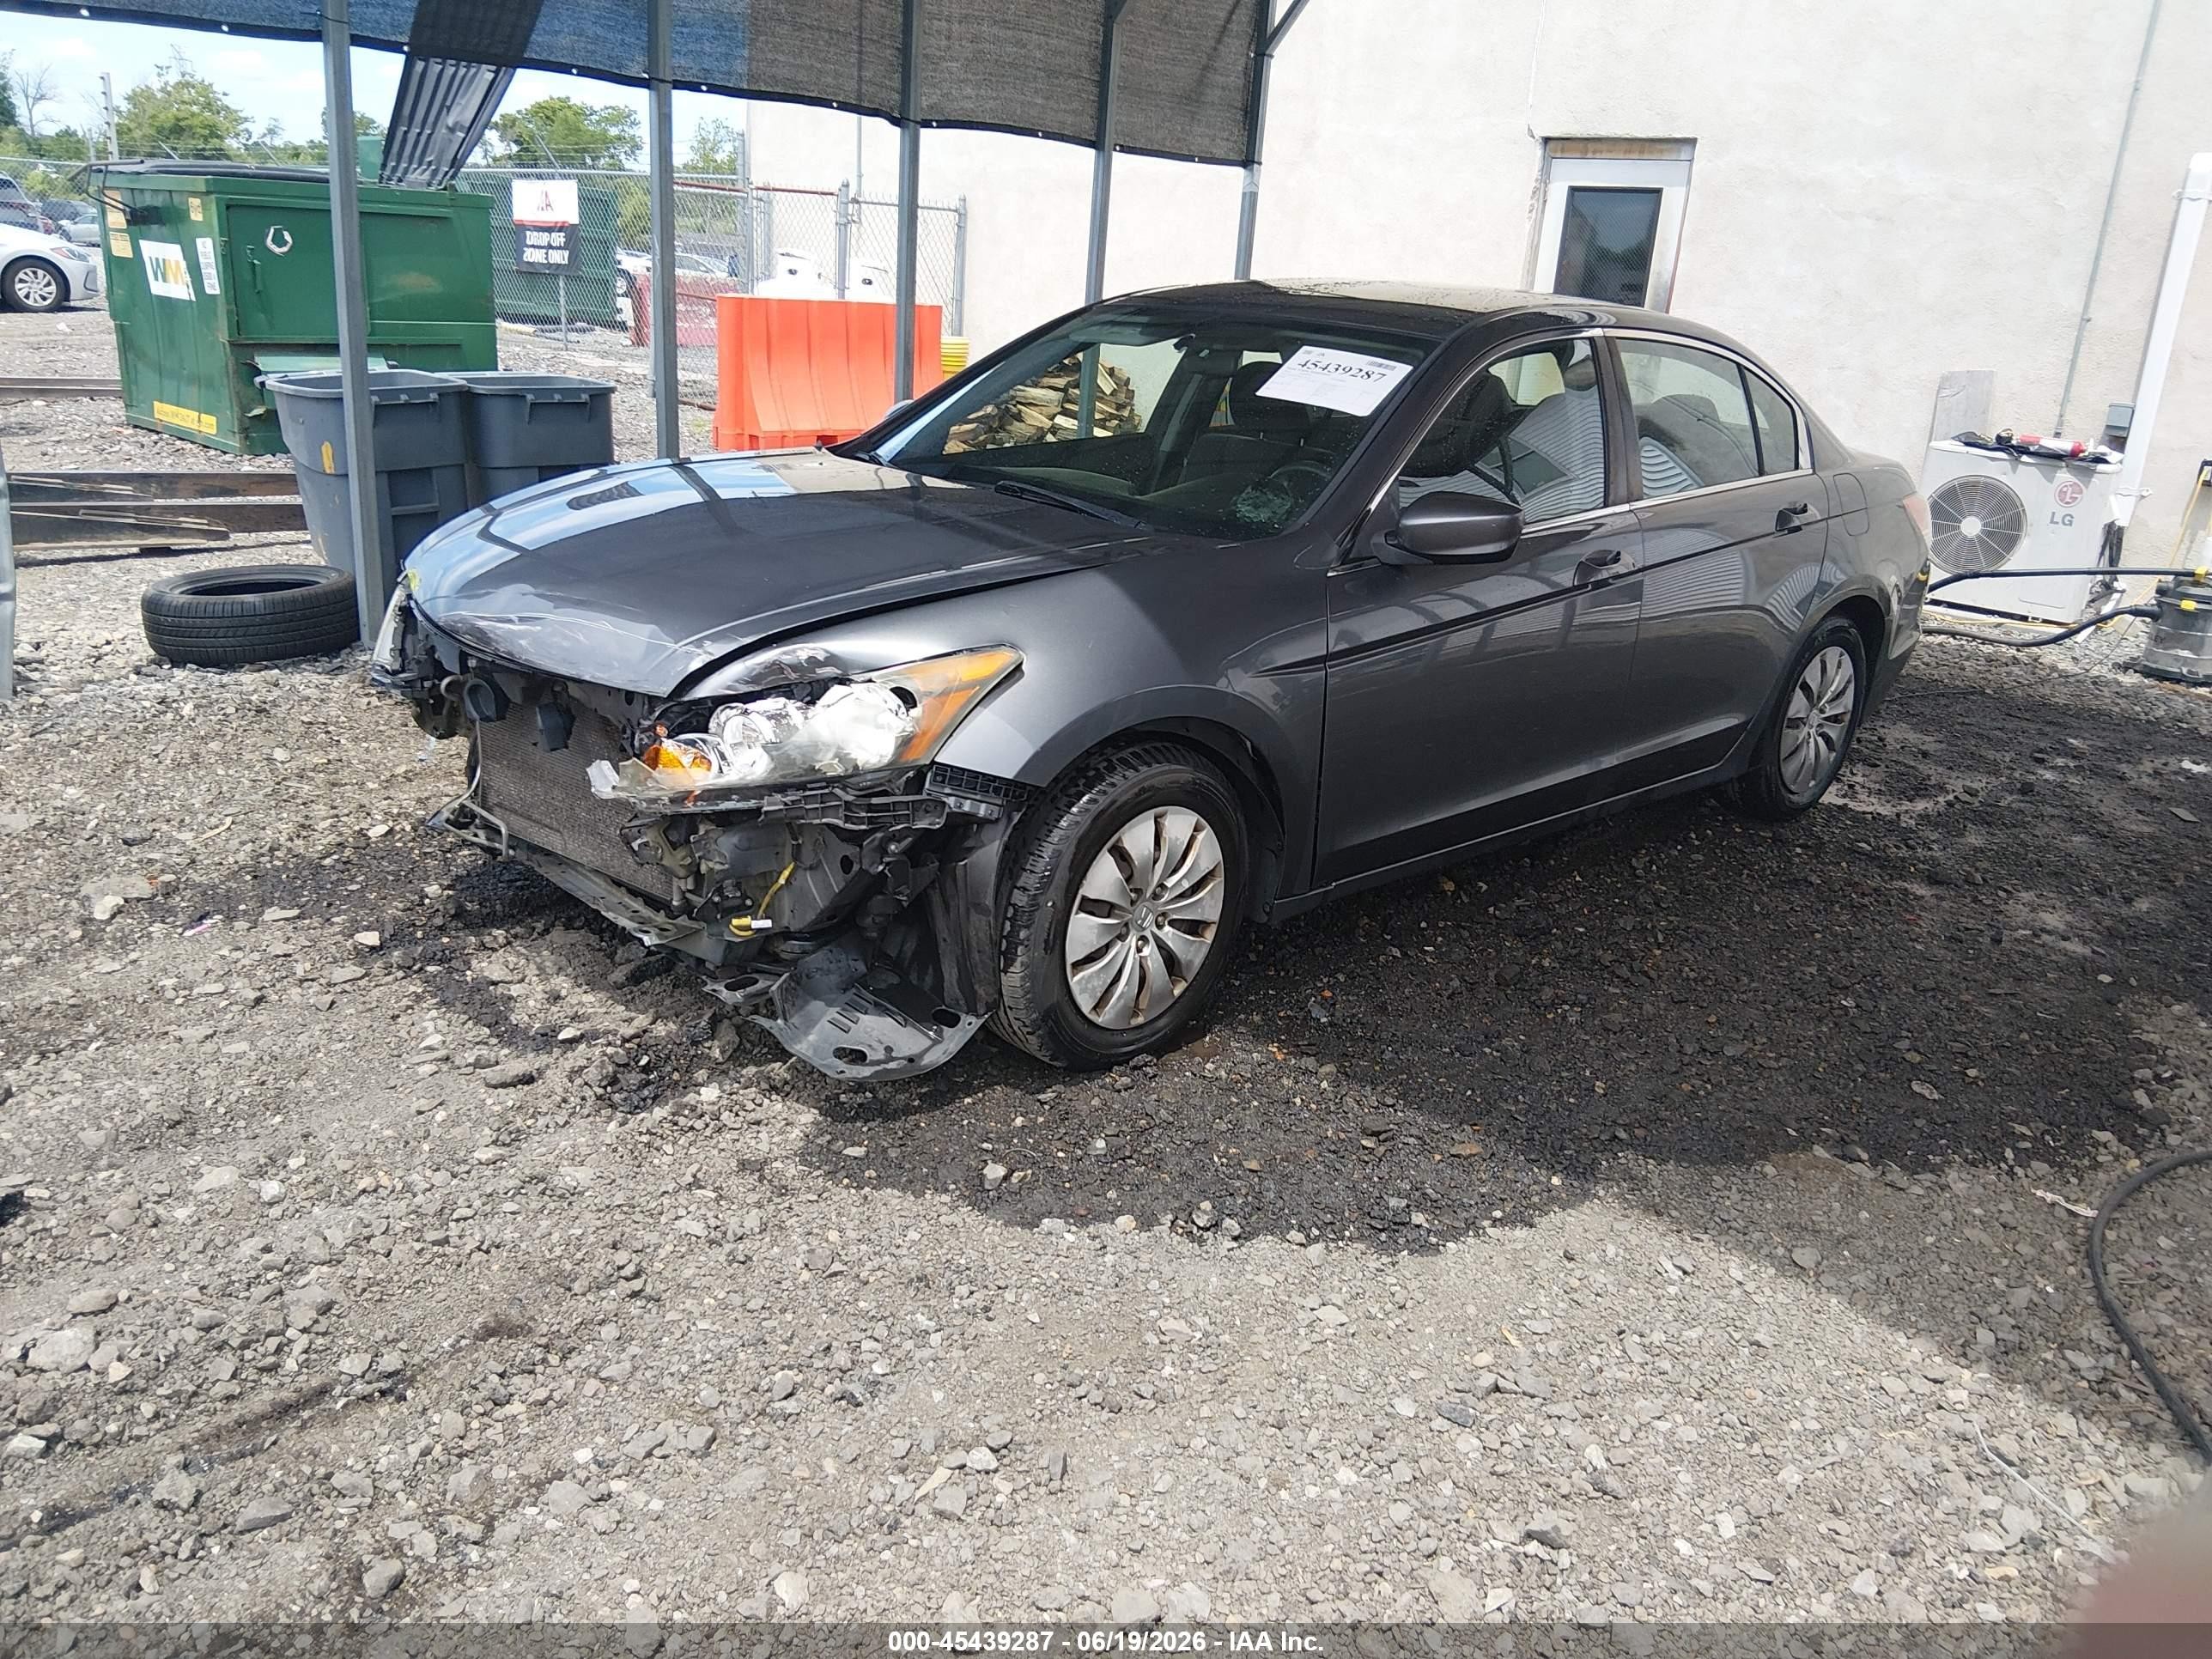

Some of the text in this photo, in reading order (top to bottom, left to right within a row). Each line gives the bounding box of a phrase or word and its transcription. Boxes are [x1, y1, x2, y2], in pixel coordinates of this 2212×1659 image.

[526, 231, 567, 247] DROP OFF
[522, 247, 570, 264] ZONE ONLY
[149, 256, 185, 285] WM
[1297, 358, 1387, 383] 45439287
[2049, 511, 2075, 526] LG
